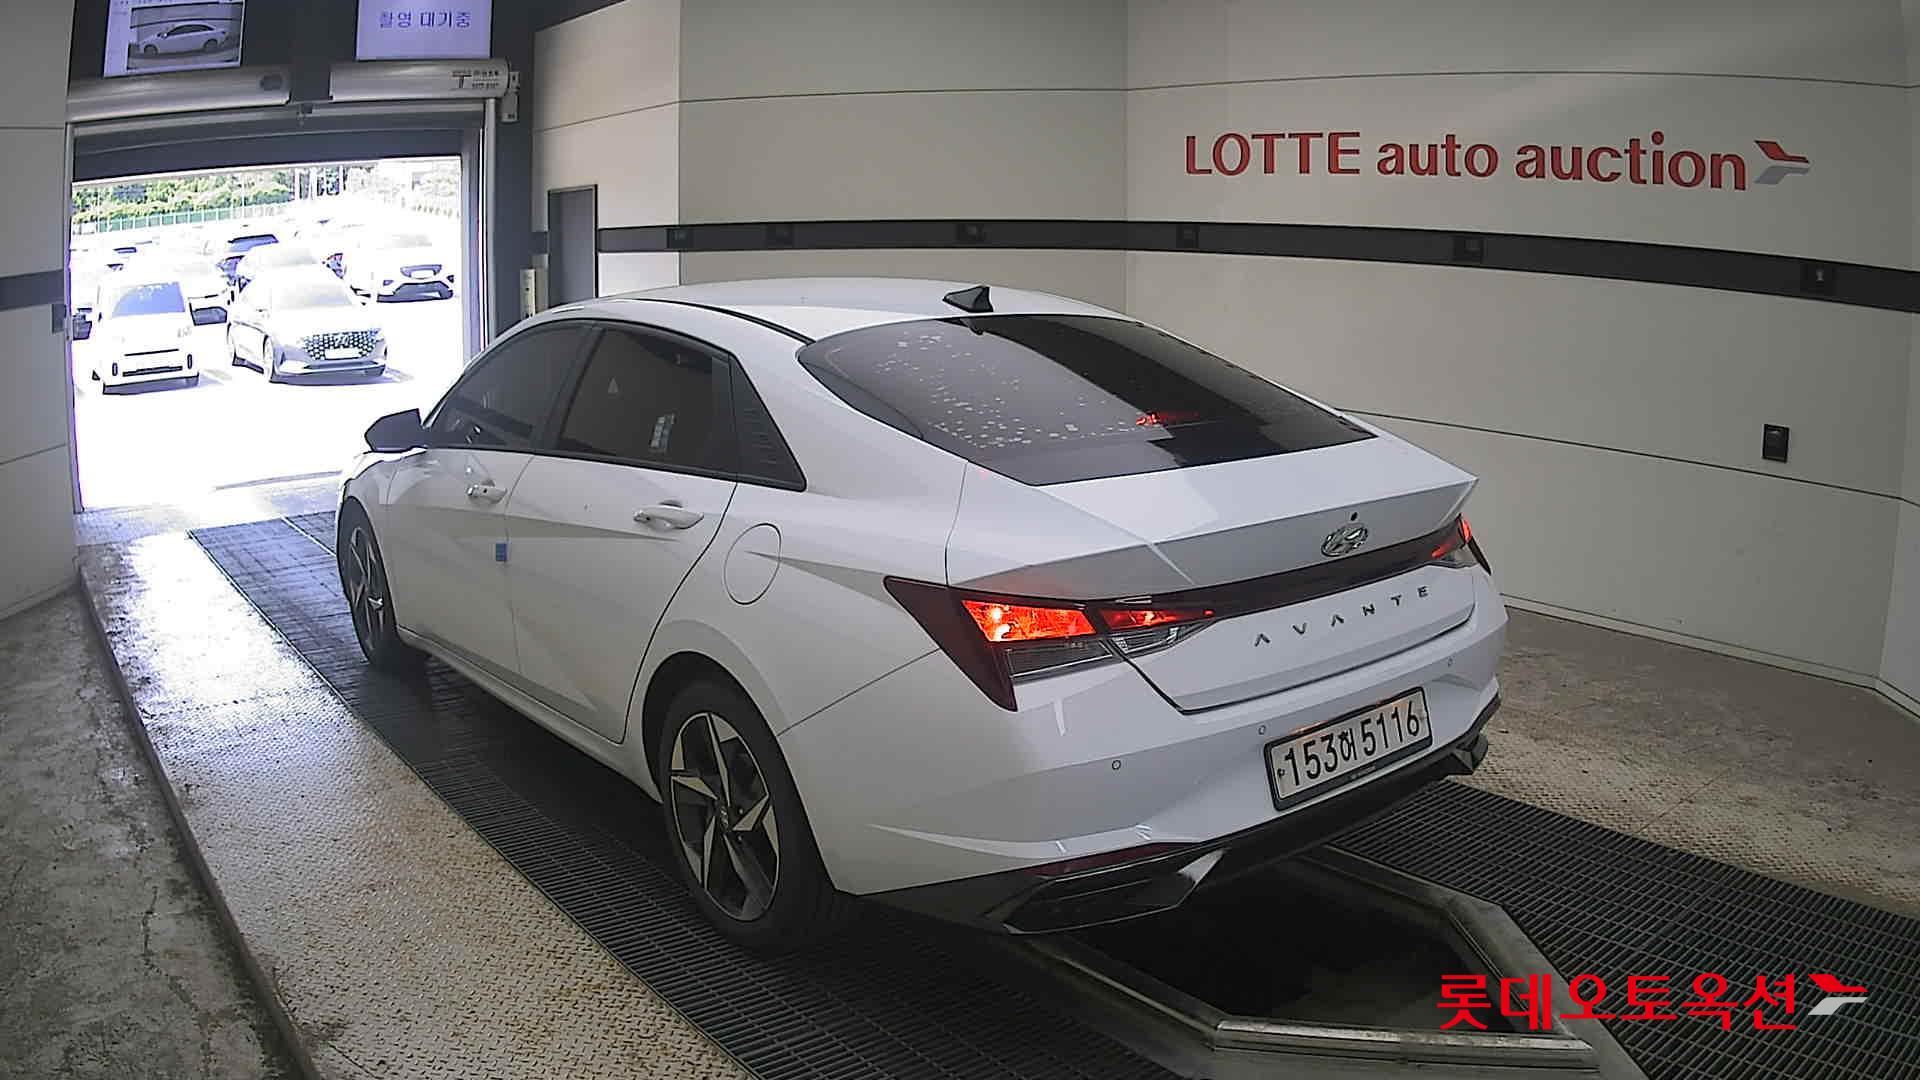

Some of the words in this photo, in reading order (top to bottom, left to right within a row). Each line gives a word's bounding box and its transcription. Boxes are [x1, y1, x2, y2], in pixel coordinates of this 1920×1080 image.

[420, 11, 472, 28] 대기중
[1186, 132, 1361, 176] LOTTE
[1377, 134, 1499, 178] auto
[1516, 131, 1746, 191] auction
[1253, 584, 1429, 647] AVANTE
